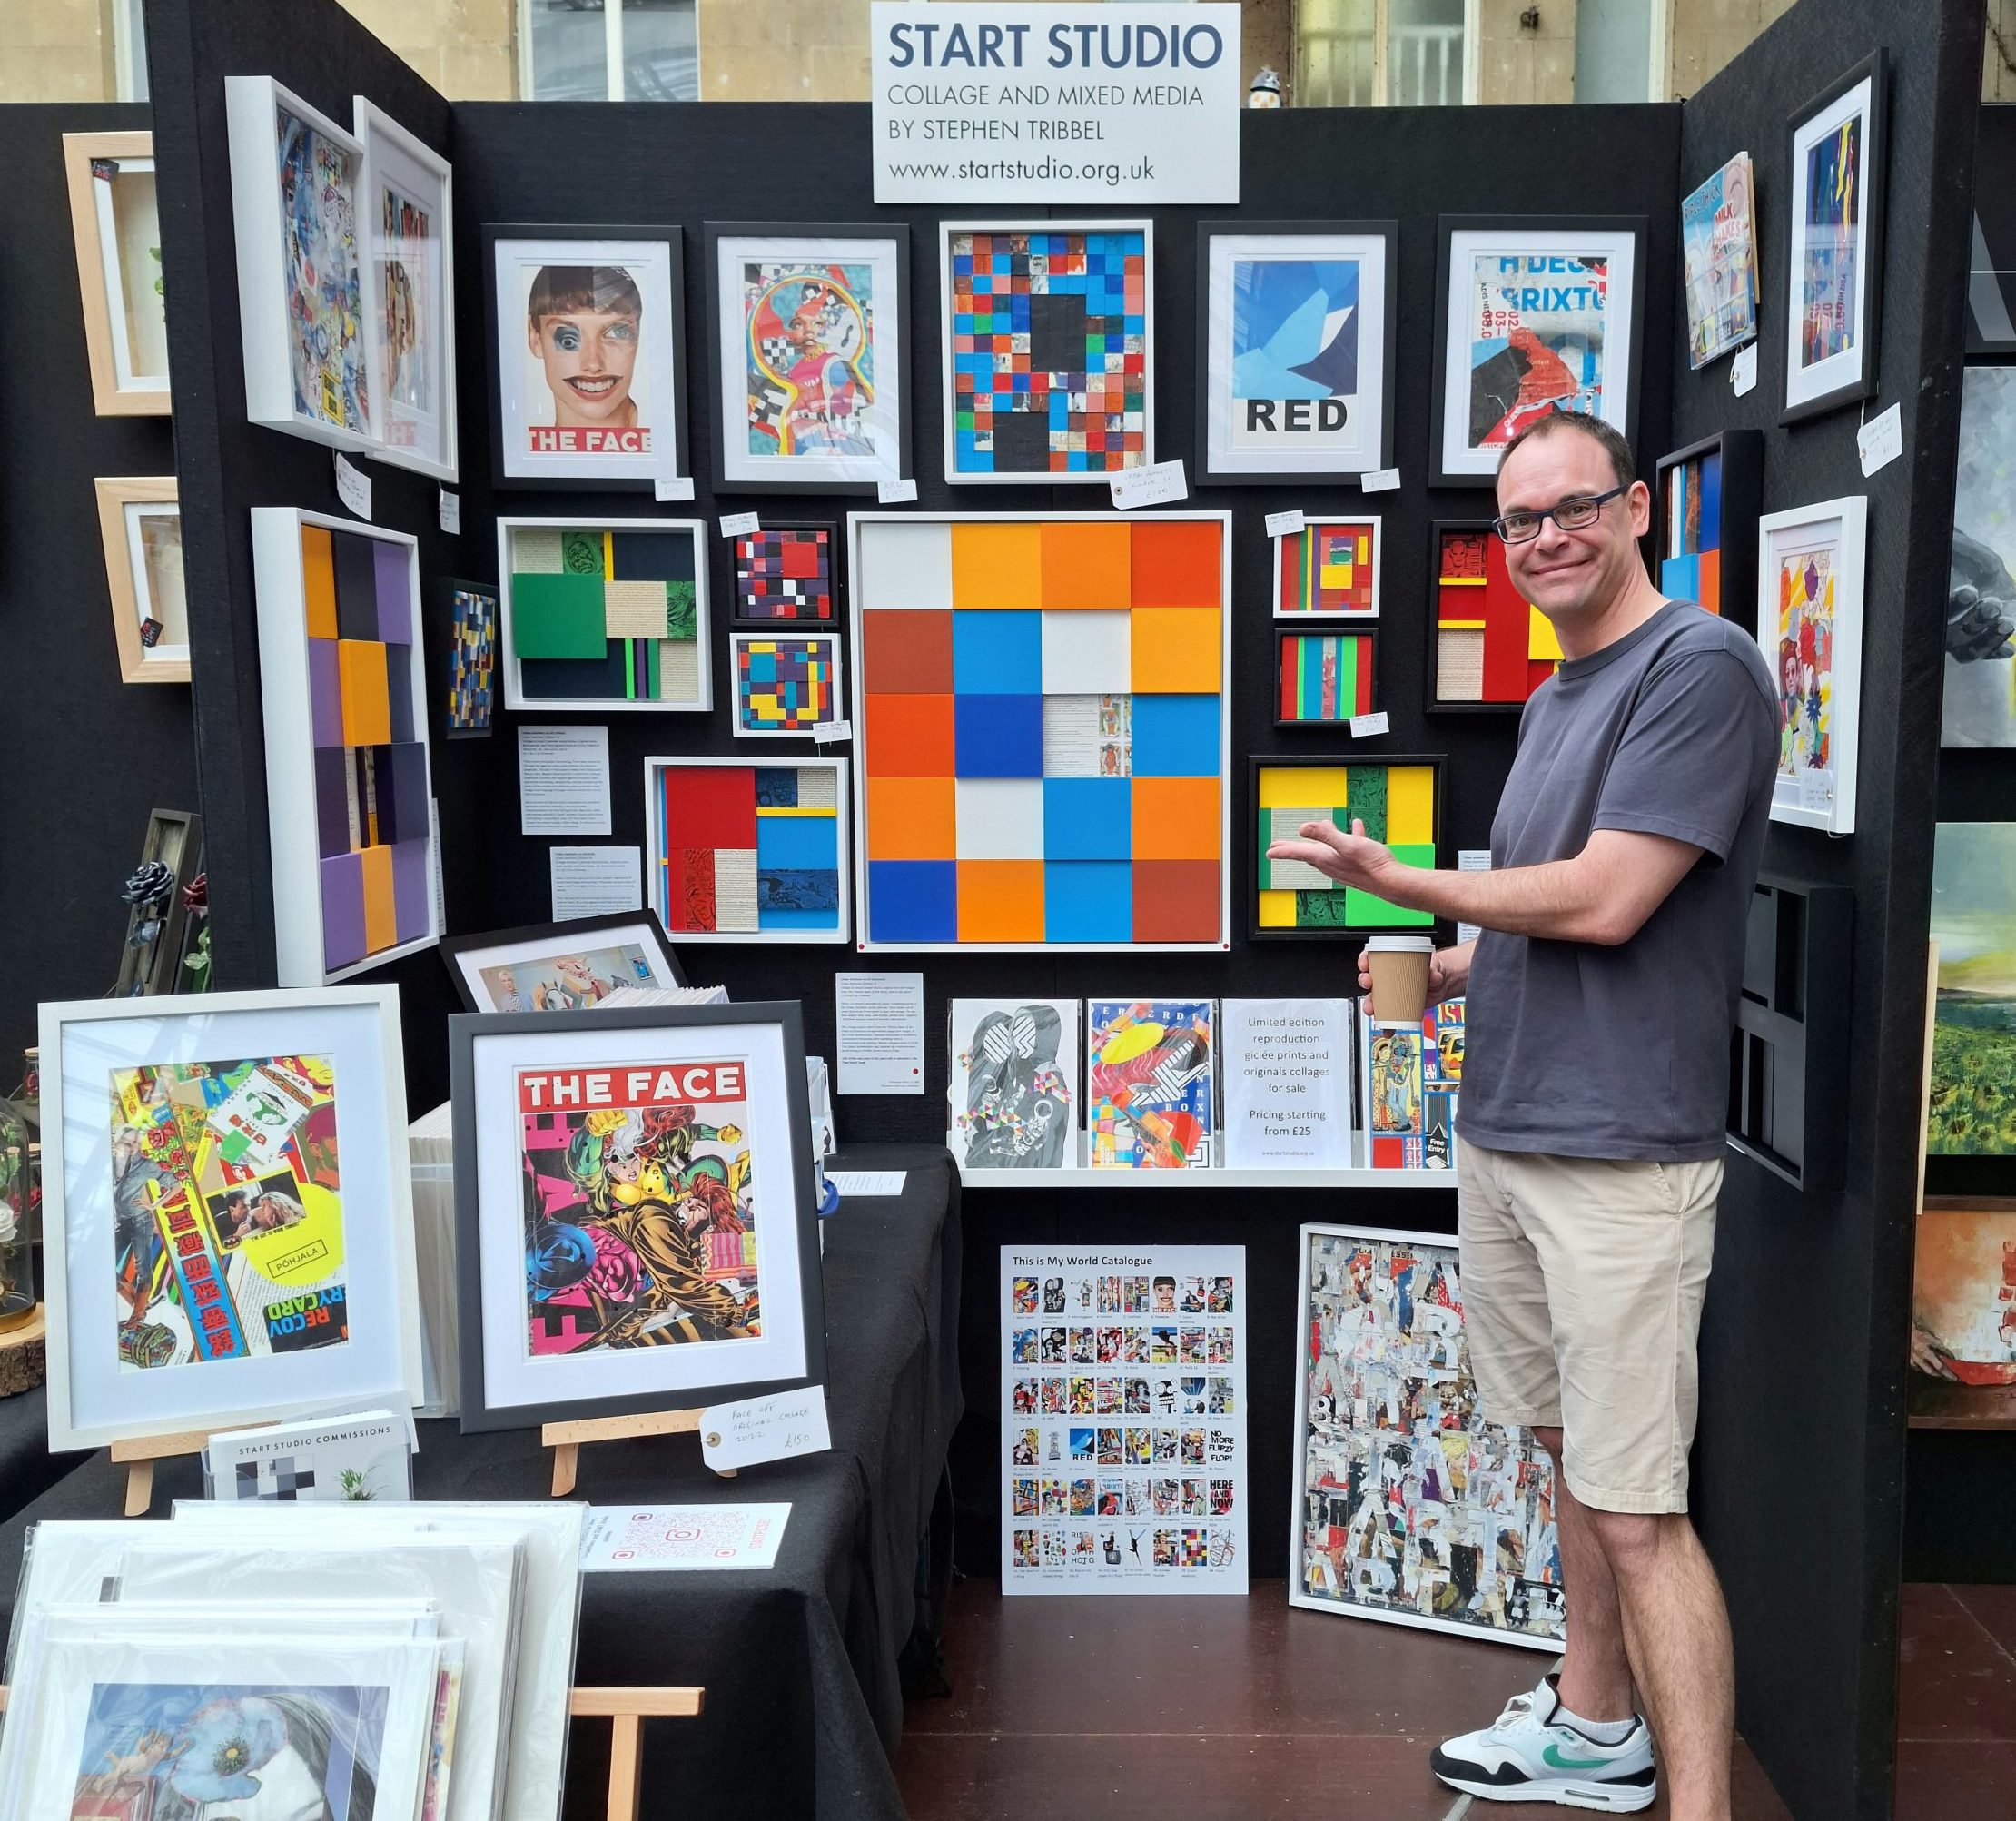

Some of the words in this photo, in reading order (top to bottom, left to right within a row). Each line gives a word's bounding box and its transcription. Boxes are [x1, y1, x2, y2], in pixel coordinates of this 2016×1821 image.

[888, 23, 1031, 68] START
[1047, 23, 1223, 68] STUDIO
[887, 84, 989, 105] COLLAGE
[998, 85, 1050, 105] AND
[1057, 85, 1126, 106] MIXED
[1132, 85, 1204, 106] MEDIA
[888, 119, 915, 140] BY
[923, 119, 1019, 141] STEPHEN
[1027, 120, 1104, 140] TRIBBEL
[888, 155, 1155, 186] www.startstudio.org.uk
[1246, 398, 1348, 432] RED
[529, 431, 578, 452] THE
[585, 431, 652, 452] FACE
[1248, 1017, 1286, 1027] Limited
[1289, 1017, 1325, 1027] edition
[1253, 1034, 1319, 1044] reproduction
[1245, 1050, 1274, 1062] giclée
[1277, 1051, 1307, 1062] prints
[1309, 1050, 1329, 1061] and
[1243, 1066, 1287, 1078] originals
[1290, 1066, 1330, 1078] collages
[523, 1074, 613, 1106] THE
[627, 1066, 741, 1103] FACE
[1269, 1084, 1283, 1093] for
[1286, 1084, 1307, 1093] sale
[1250, 1110, 1284, 1122] Pricing
[1287, 1110, 1327, 1122] starting
[1264, 1126, 1290, 1136] from
[1292, 1126, 1311, 1136] £25
[1429, 1138, 1445, 1147] Free
[1428, 1144, 1446, 1154] Entry
[276, 1248, 319, 1272] PÕHJALA
[1013, 1256, 1033, 1266] This
[1036, 1256, 1044, 1266] is
[1047, 1256, 1064, 1267] My
[1067, 1256, 1099, 1266] World
[1102, 1255, 1153, 1267] Catalogue
[270, 1306, 331, 1338] RECOV
[732, 1410, 751, 1420] FACE
[239, 1444, 272, 1455] START
[274, 1438, 312, 1450] STUDIO
[316, 1426, 391, 1444] COMMISSIONS
[1072, 1453, 1093, 1461] RED
[1209, 1480, 1234, 1489] HERE
[1210, 1498, 1234, 1509] NOW
